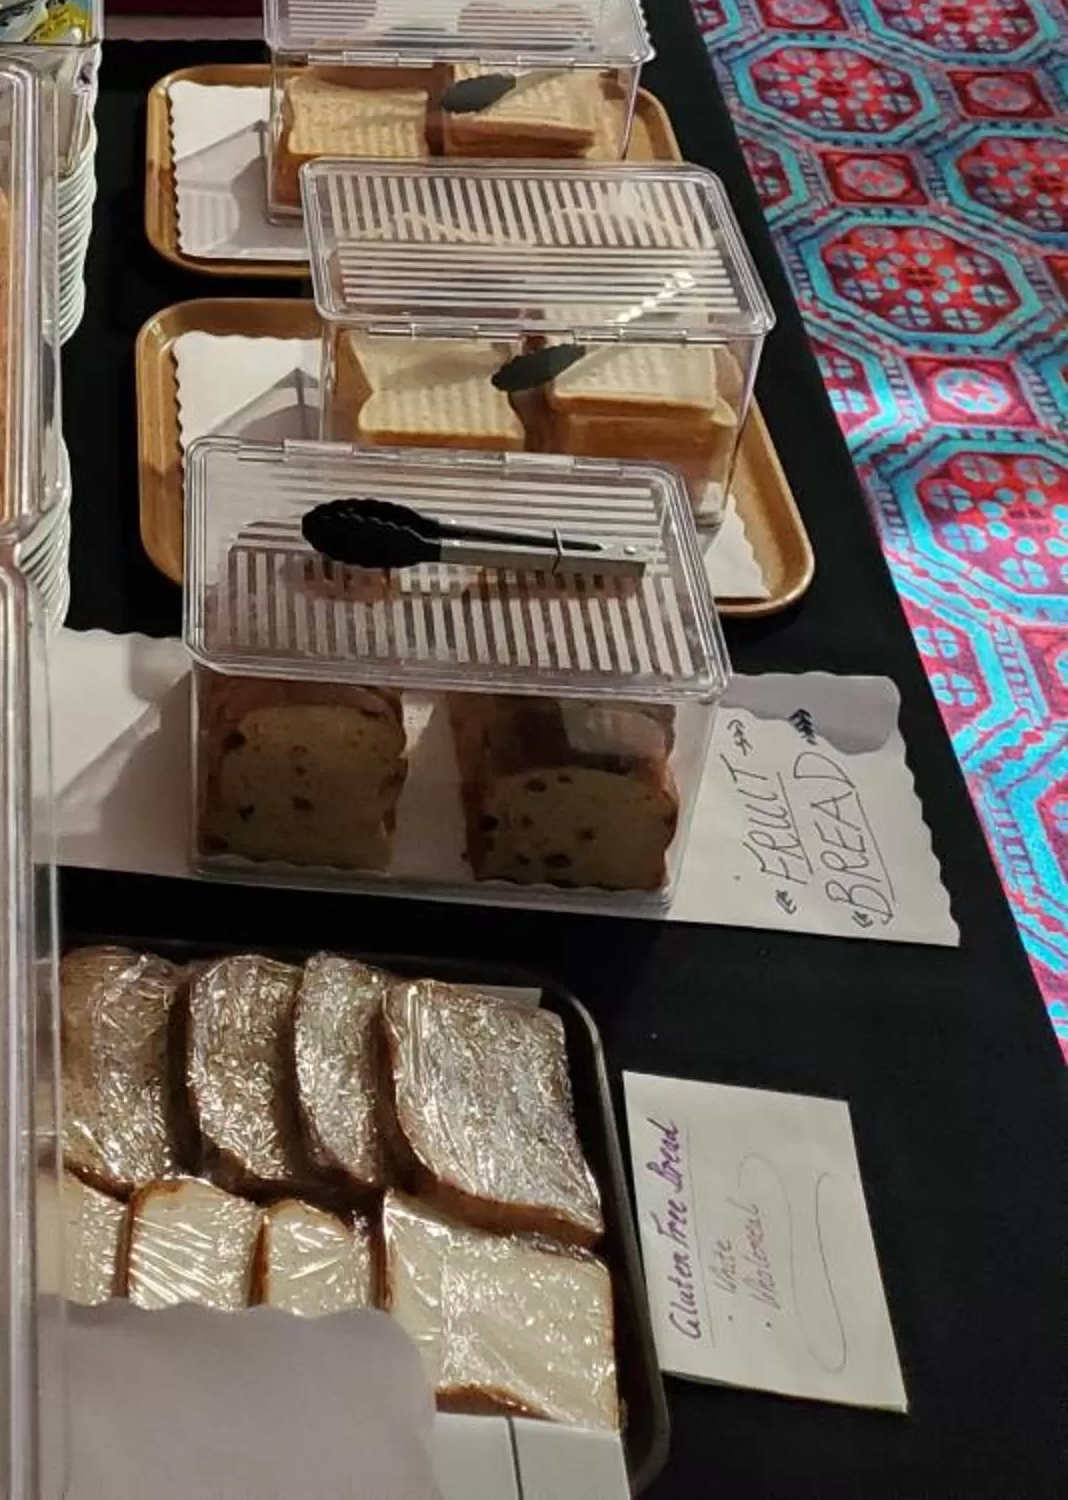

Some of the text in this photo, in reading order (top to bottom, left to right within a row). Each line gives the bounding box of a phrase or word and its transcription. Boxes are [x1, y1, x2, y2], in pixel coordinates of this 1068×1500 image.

[720, 753, 809, 886] FRUIT
[793, 751, 895, 926] BREAD
[649, 1199, 691, 1250] Free
[668, 1252, 702, 1340] Gluten
